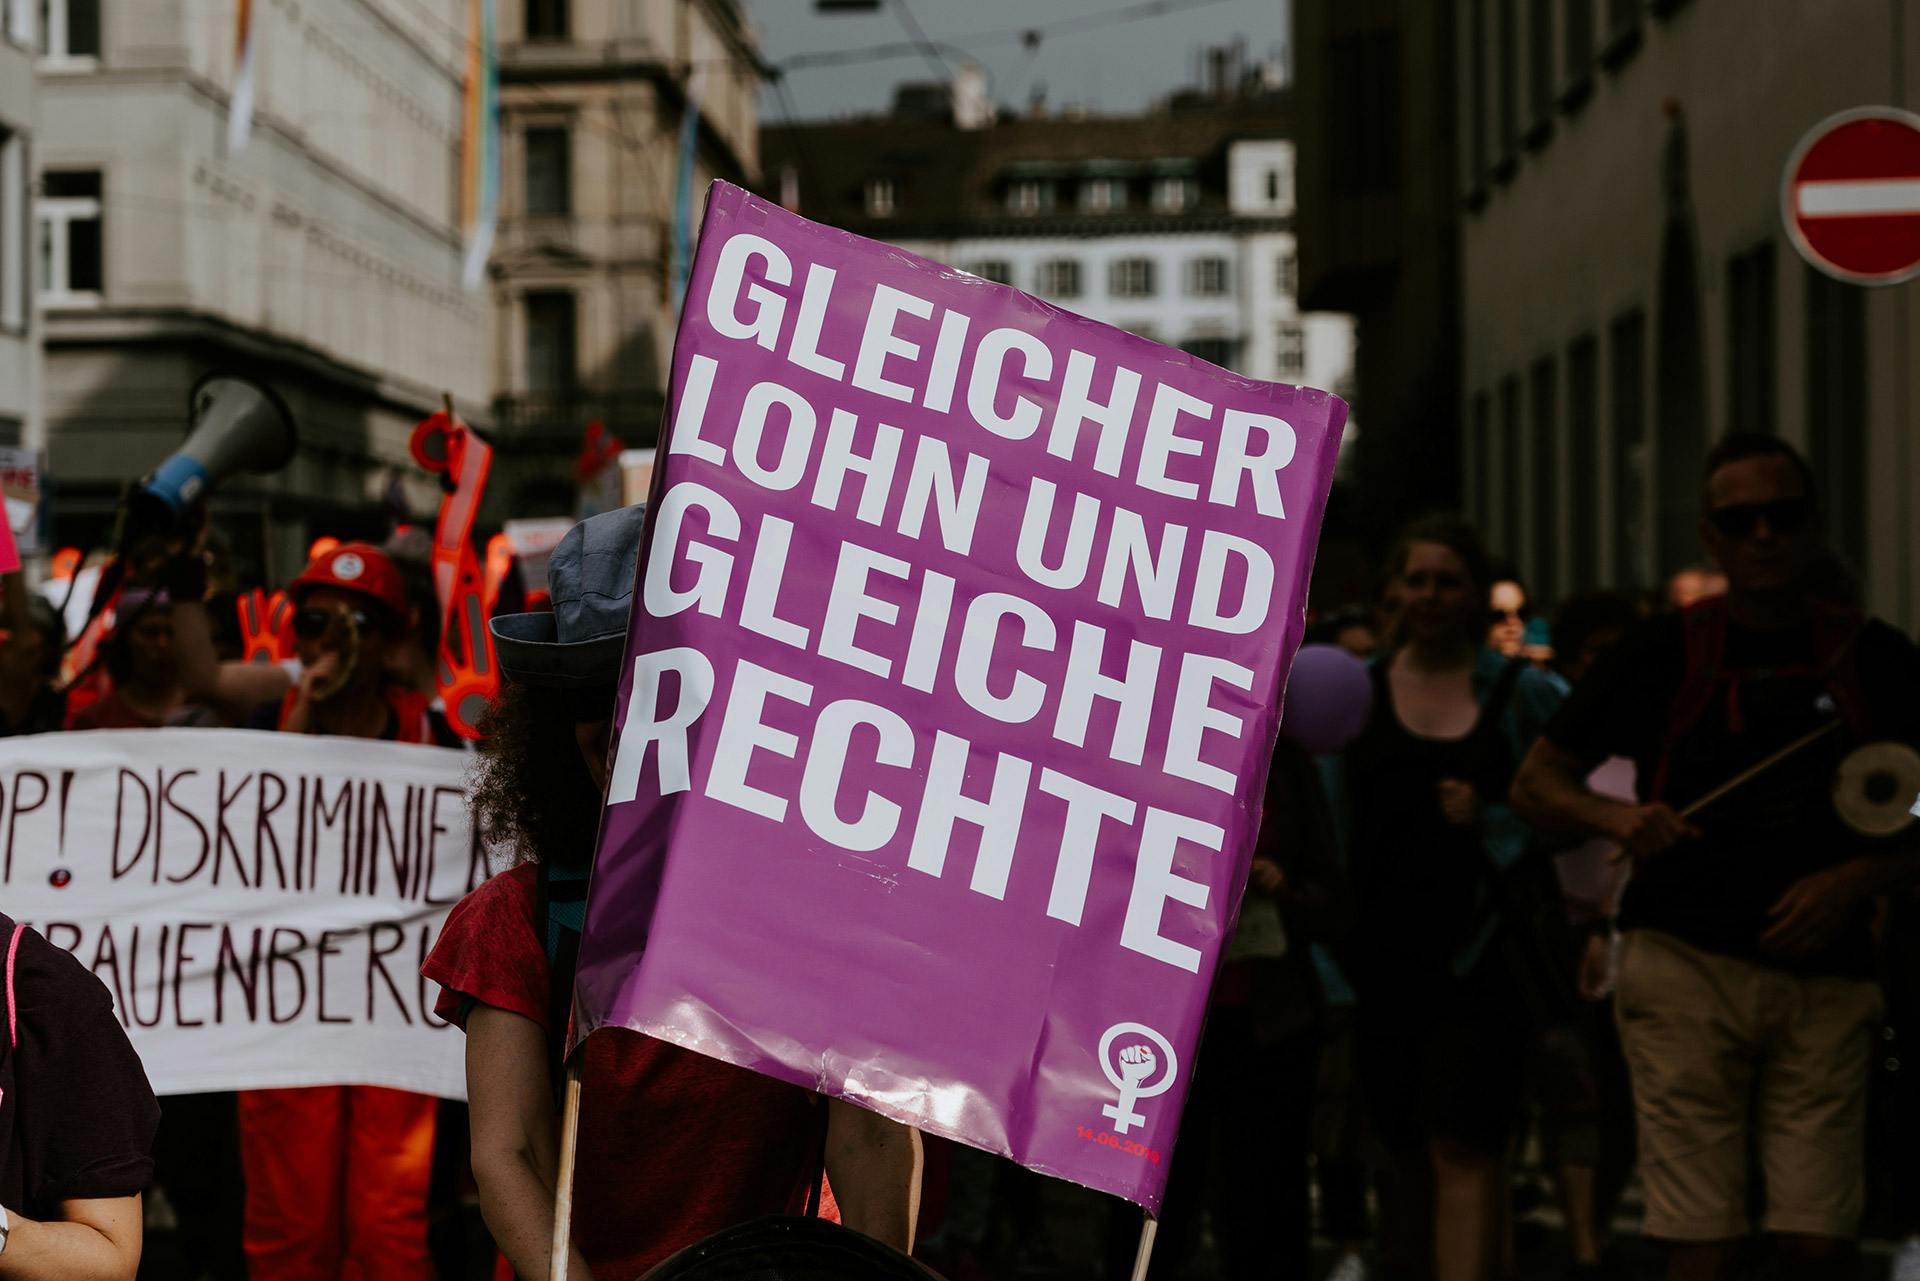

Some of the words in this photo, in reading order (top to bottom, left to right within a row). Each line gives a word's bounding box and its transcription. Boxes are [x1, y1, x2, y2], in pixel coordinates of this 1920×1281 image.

[669, 354, 990, 556] LOHN
[1016, 476, 1274, 634] UND
[707, 233, 1296, 519] GLEICHER
[644, 482, 1254, 796] GLEICHE
[0, 770, 74, 888] P!
[607, 647, 1225, 974] RECHTE
[1077, 1126, 1160, 1164] 14.06.2019
